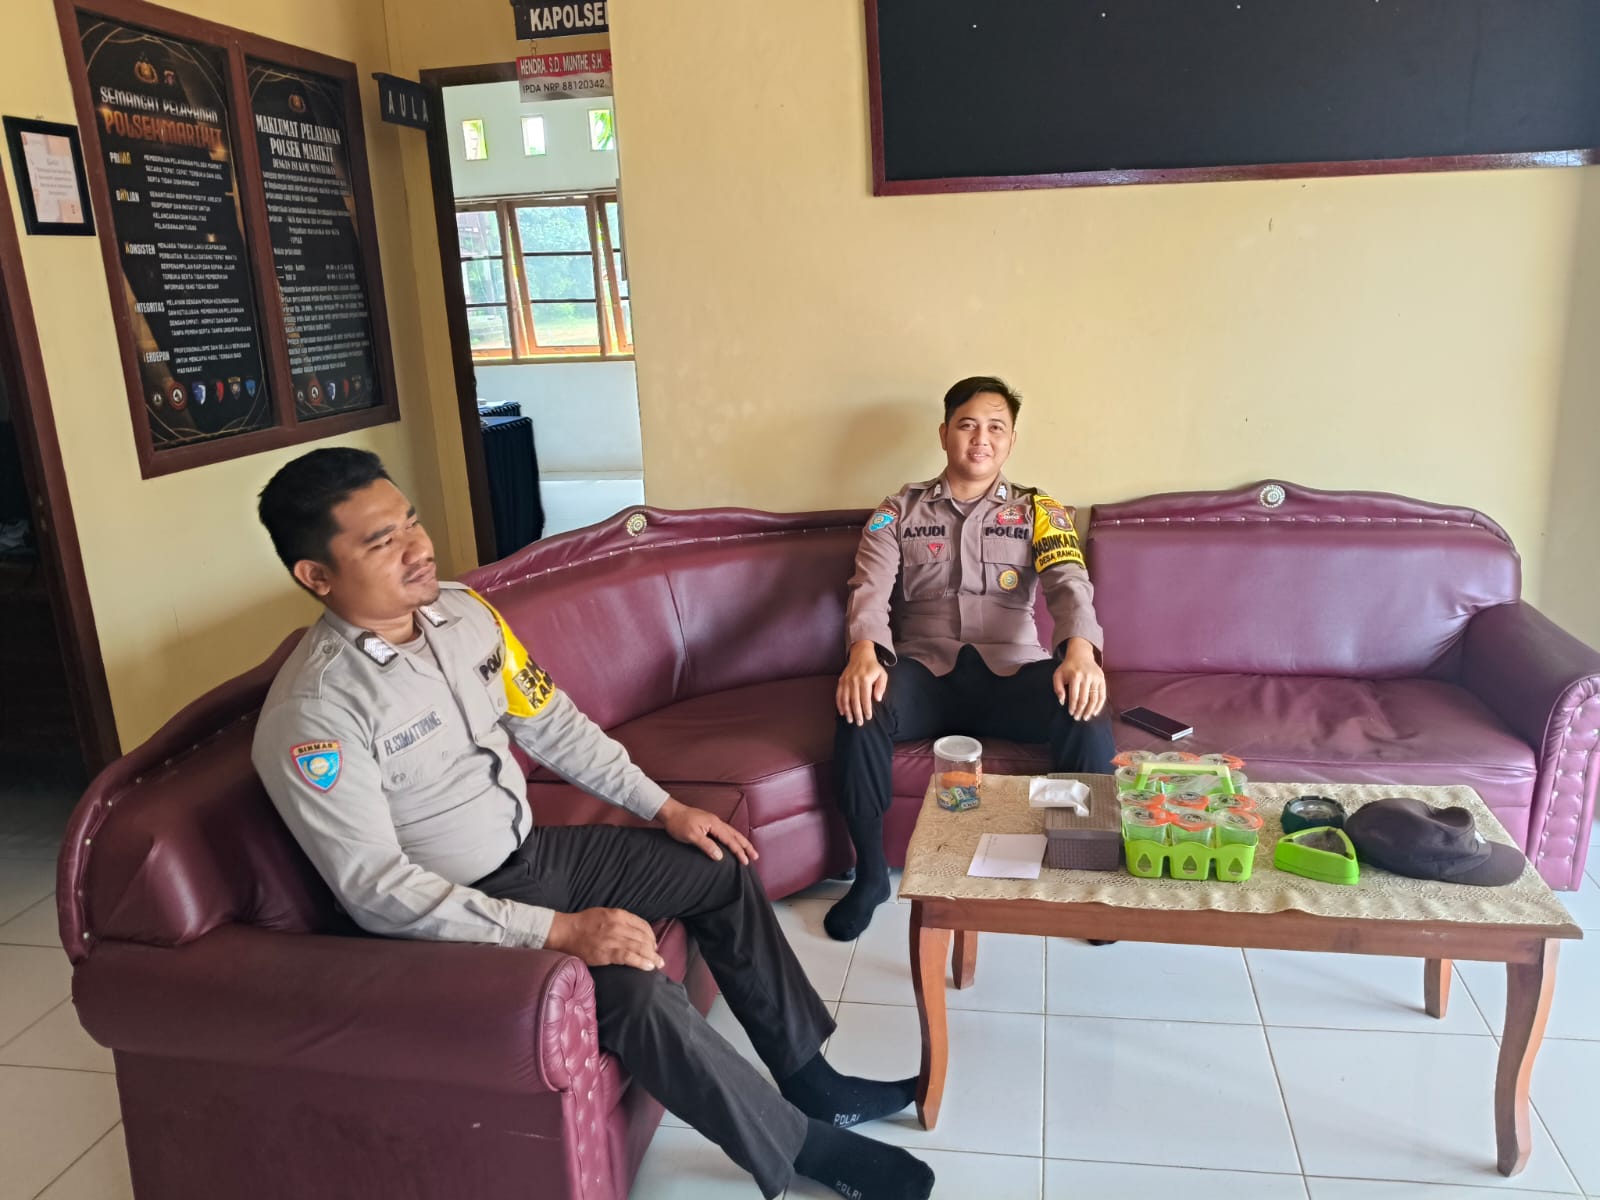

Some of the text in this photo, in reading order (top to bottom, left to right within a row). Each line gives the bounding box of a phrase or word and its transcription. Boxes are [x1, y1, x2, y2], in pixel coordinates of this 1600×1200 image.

[523, 79, 605, 94] IPDA NRP 88120342
[100, 86, 160, 111] SEMANGAT
[255, 114, 341, 144] MAKLUMAT PELAYANAN
[269, 137, 301, 158] POLSEK
[903, 525, 945, 538] A.YUDI
[985, 526, 1029, 540] POLRI
[1039, 553, 1056, 566] DESA
[479, 646, 502, 681] POL
[834, 1113, 861, 1127] POLRI
[836, 1180, 862, 1200] POLRI
